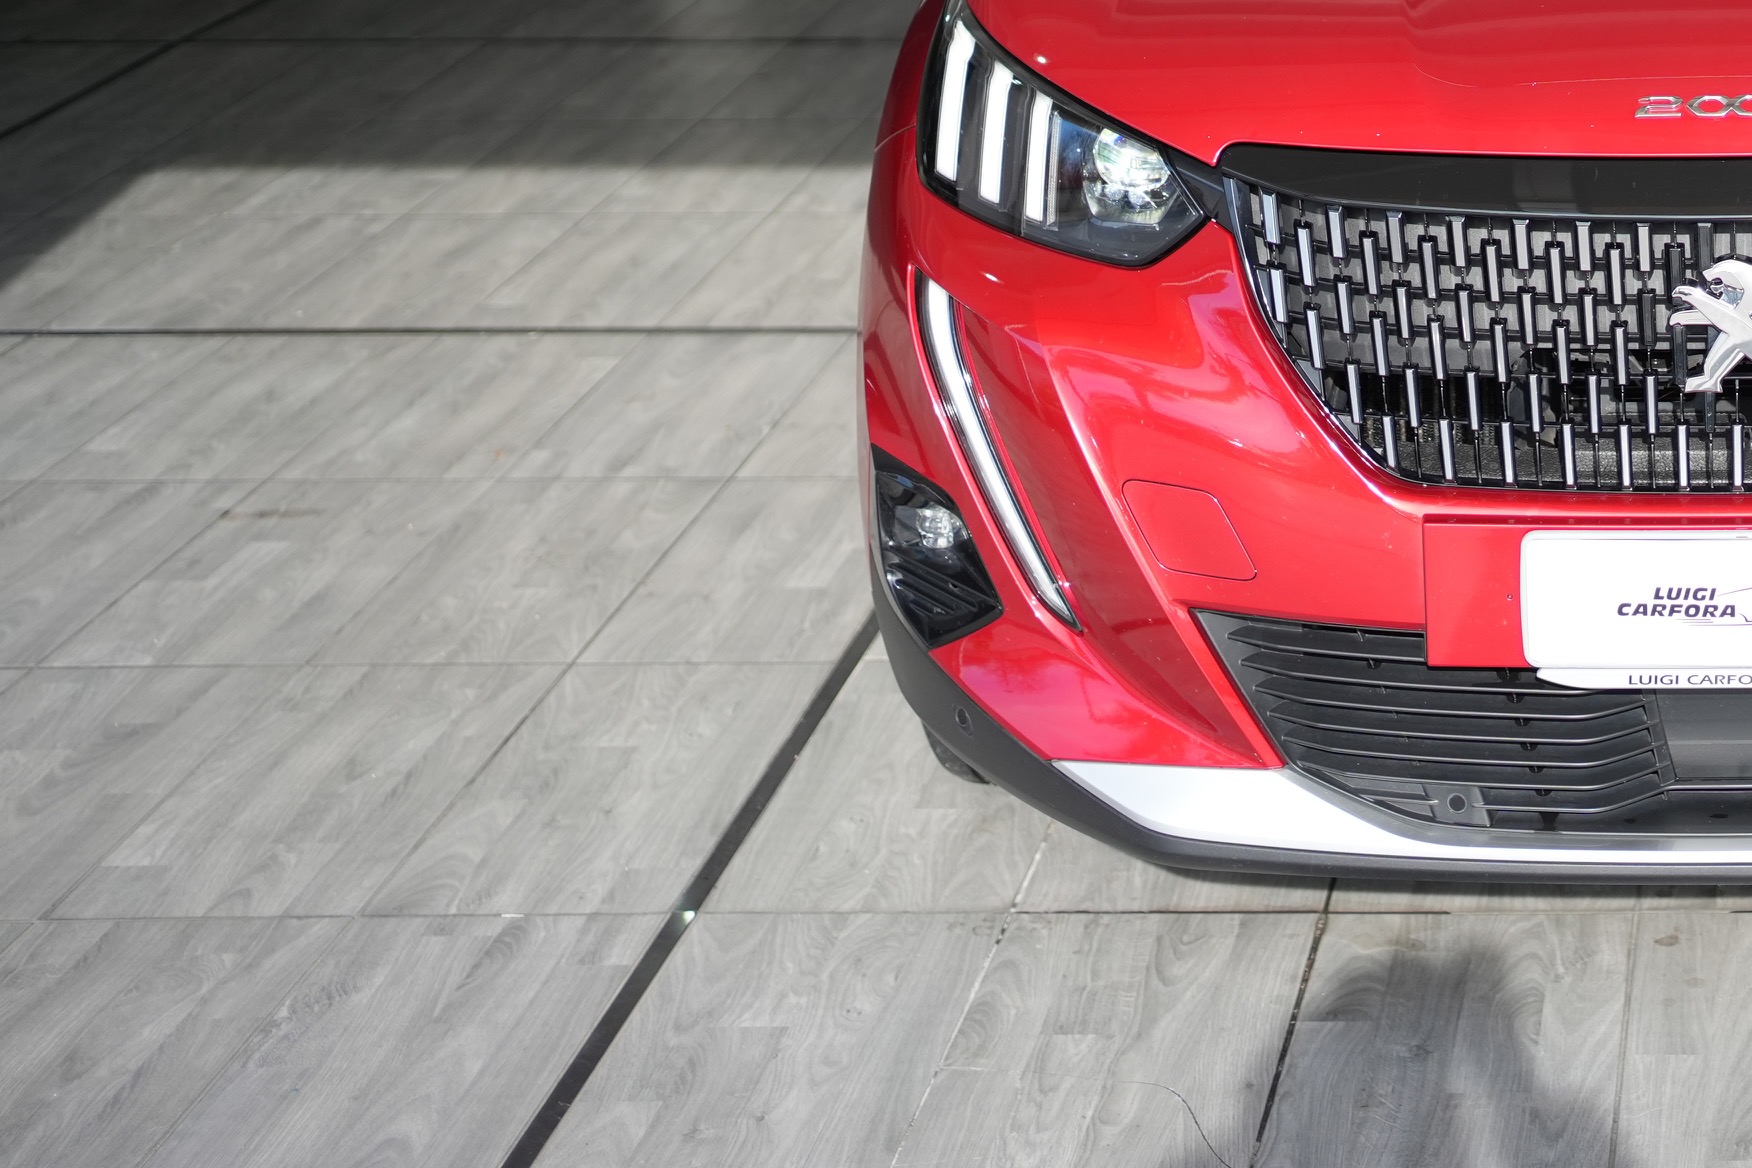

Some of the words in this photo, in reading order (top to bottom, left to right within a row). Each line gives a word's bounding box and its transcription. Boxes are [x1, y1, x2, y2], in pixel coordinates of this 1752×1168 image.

[1654, 587, 1717, 601] LUIGI
[1617, 603, 1737, 618] CARFORA
[1628, 674, 1680, 686] LUIGI
